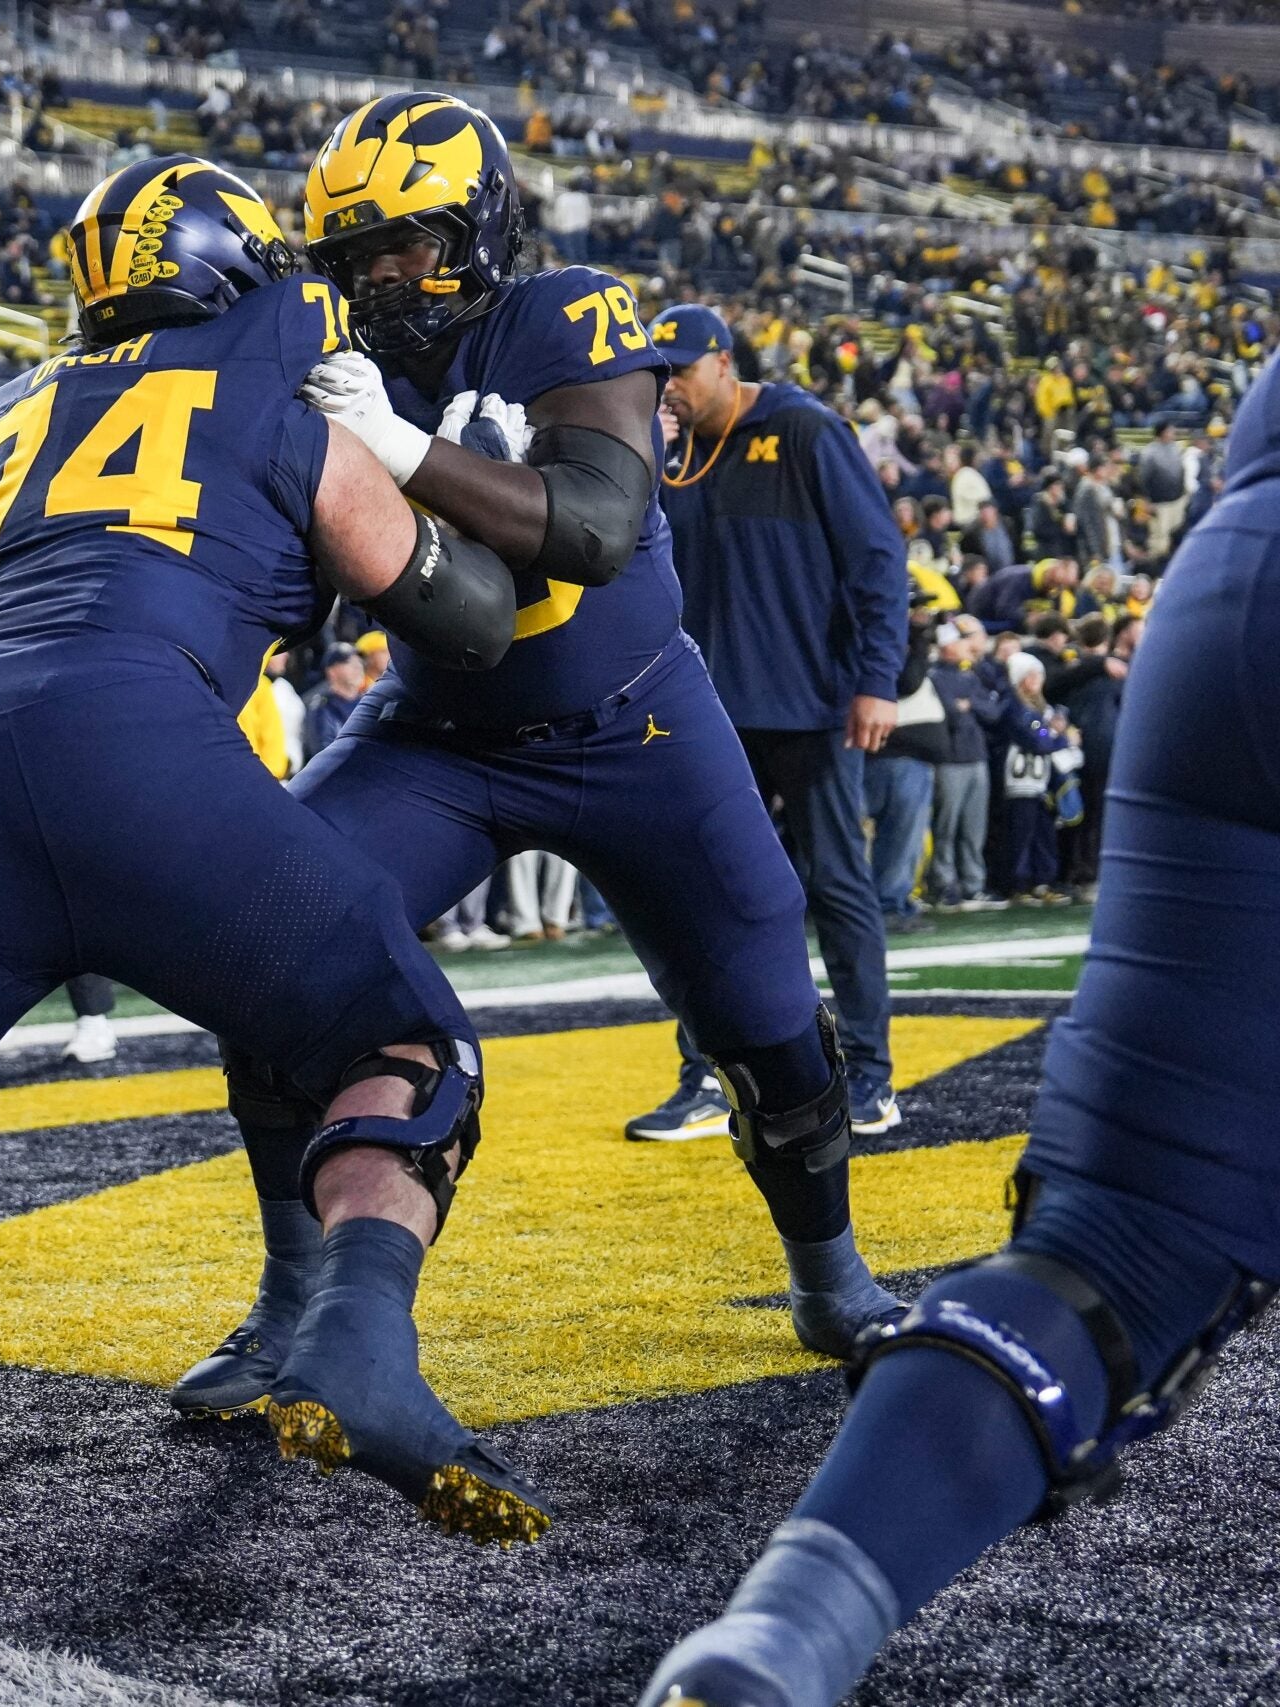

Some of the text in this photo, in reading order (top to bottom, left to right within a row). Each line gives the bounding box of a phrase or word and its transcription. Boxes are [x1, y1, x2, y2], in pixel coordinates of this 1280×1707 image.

[337, 208, 358, 228] M
[563, 286, 648, 365] 79
[652, 321, 678, 341] M
[746, 435, 780, 462] M
